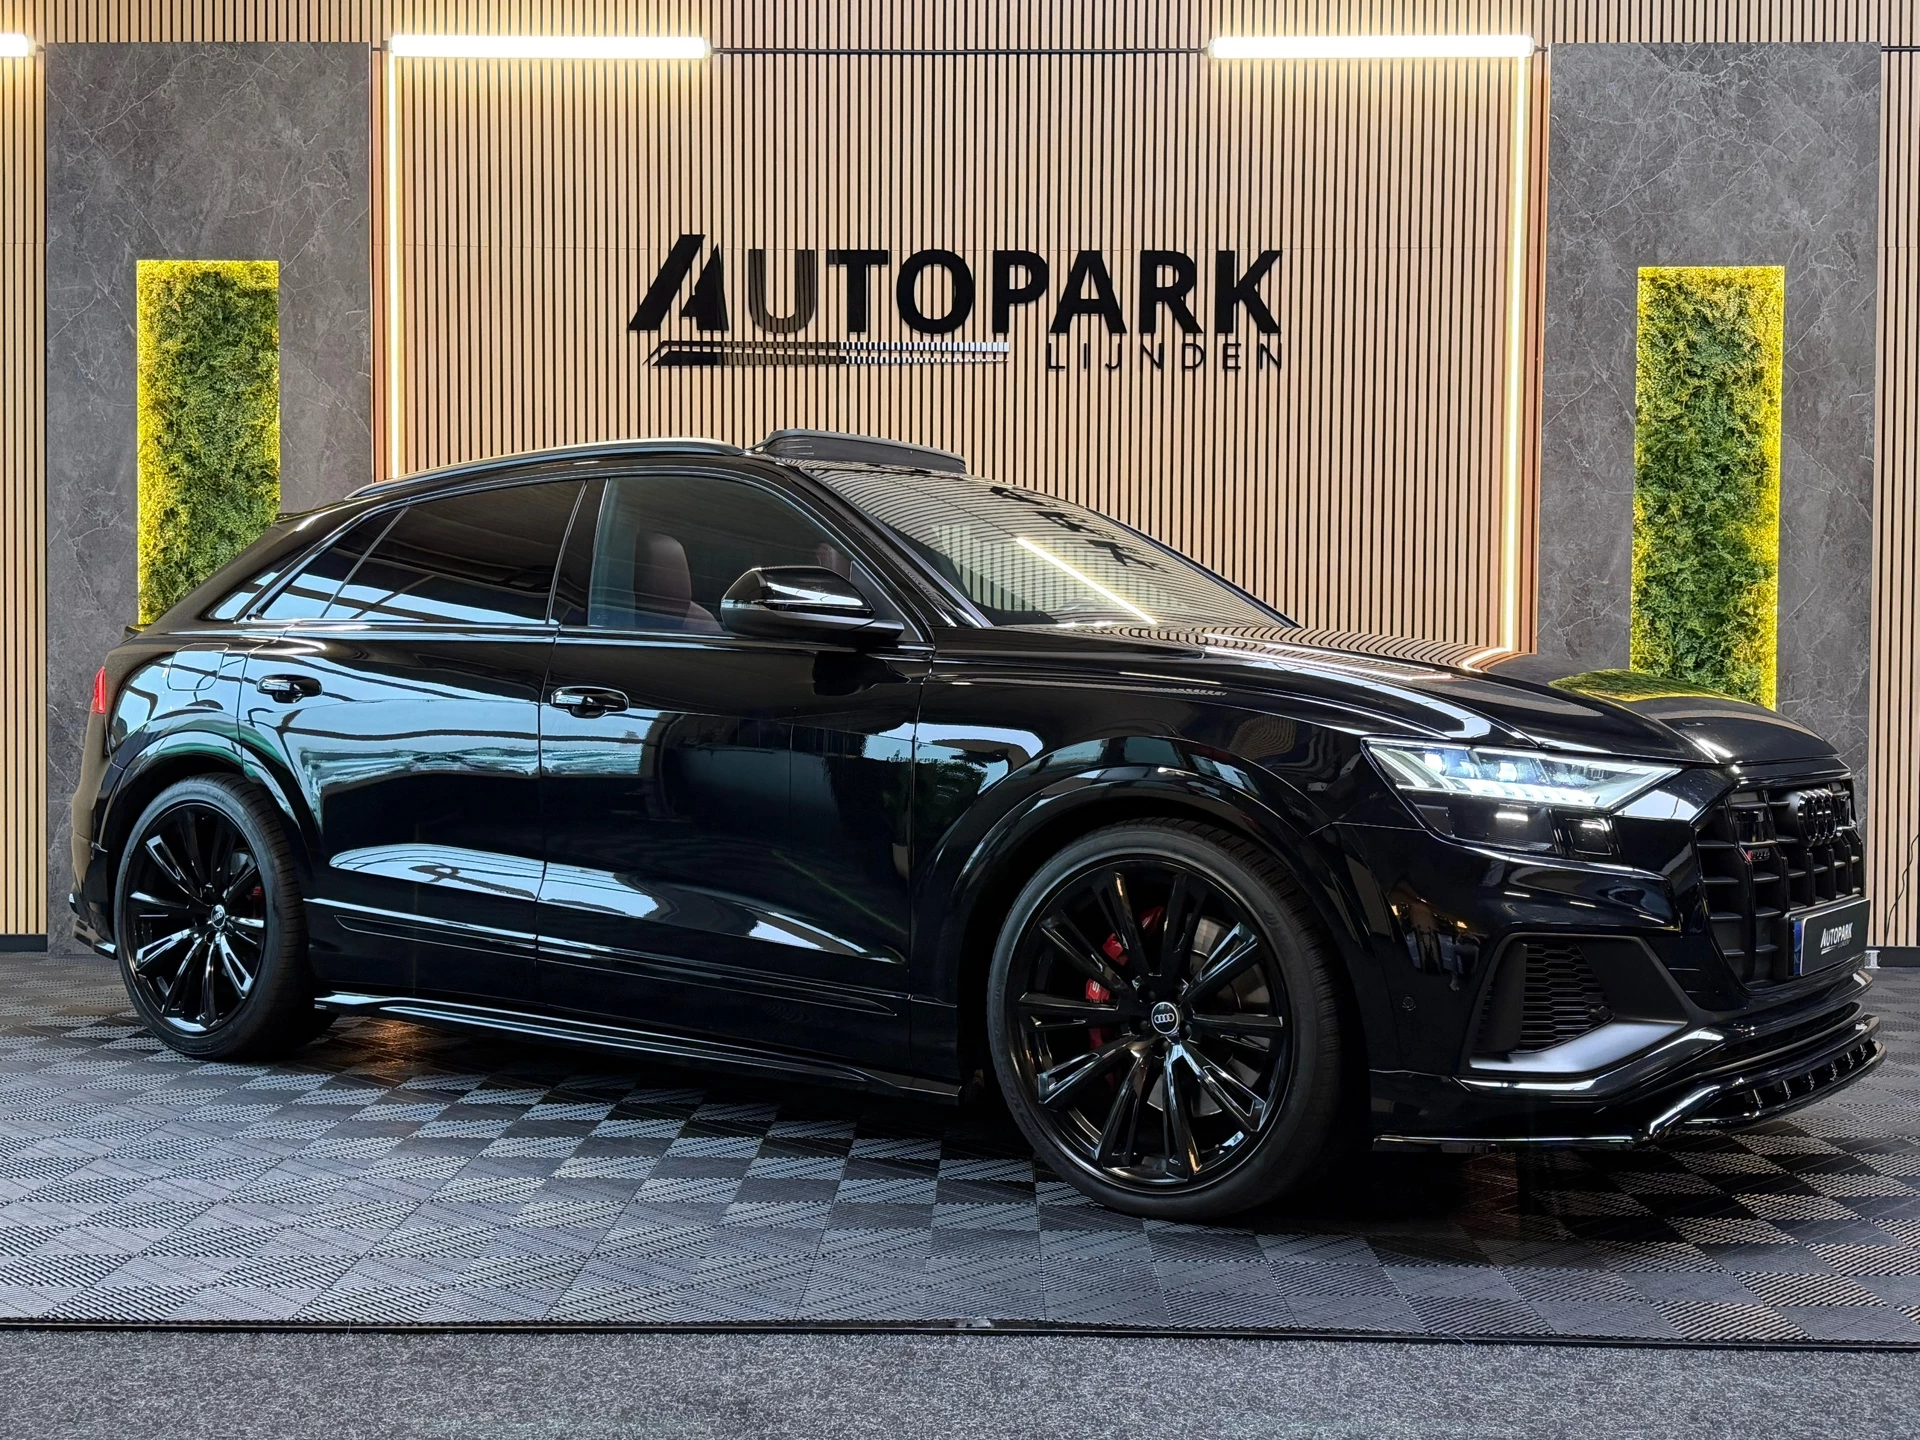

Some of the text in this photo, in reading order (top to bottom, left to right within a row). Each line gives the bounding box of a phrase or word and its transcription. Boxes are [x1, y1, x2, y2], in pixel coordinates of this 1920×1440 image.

[627, 234, 1282, 334] AUTOPARK
[1047, 342, 1282, 371] LIJNDEN
[1820, 922, 1853, 948] AUTOPARK
